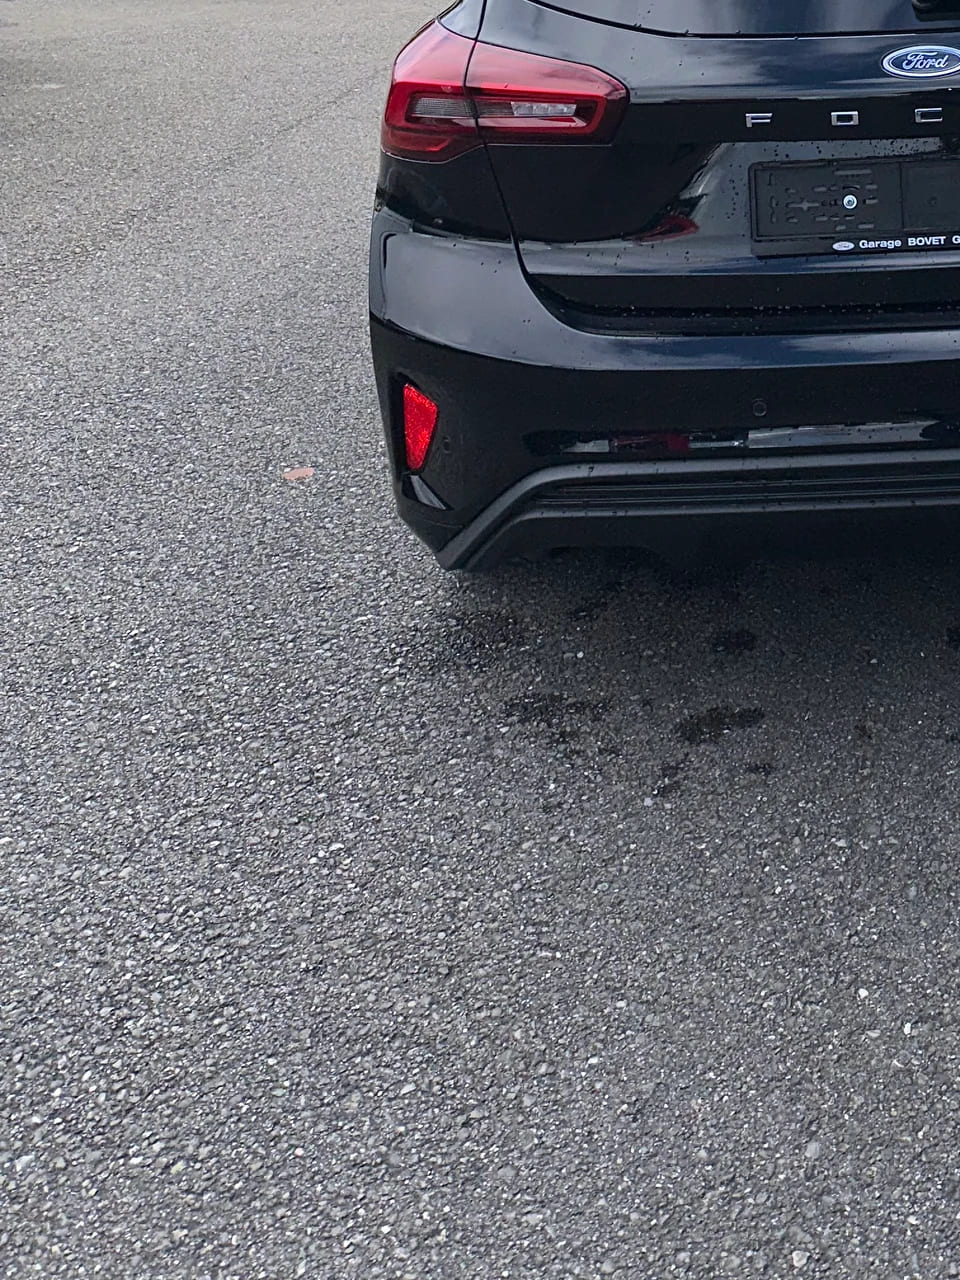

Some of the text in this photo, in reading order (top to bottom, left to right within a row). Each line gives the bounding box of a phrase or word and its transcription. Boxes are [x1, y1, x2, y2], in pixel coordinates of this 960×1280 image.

[902, 51, 948, 70] Ford
[859, 239, 902, 249] Garage
[907, 236, 947, 246] BOVET
